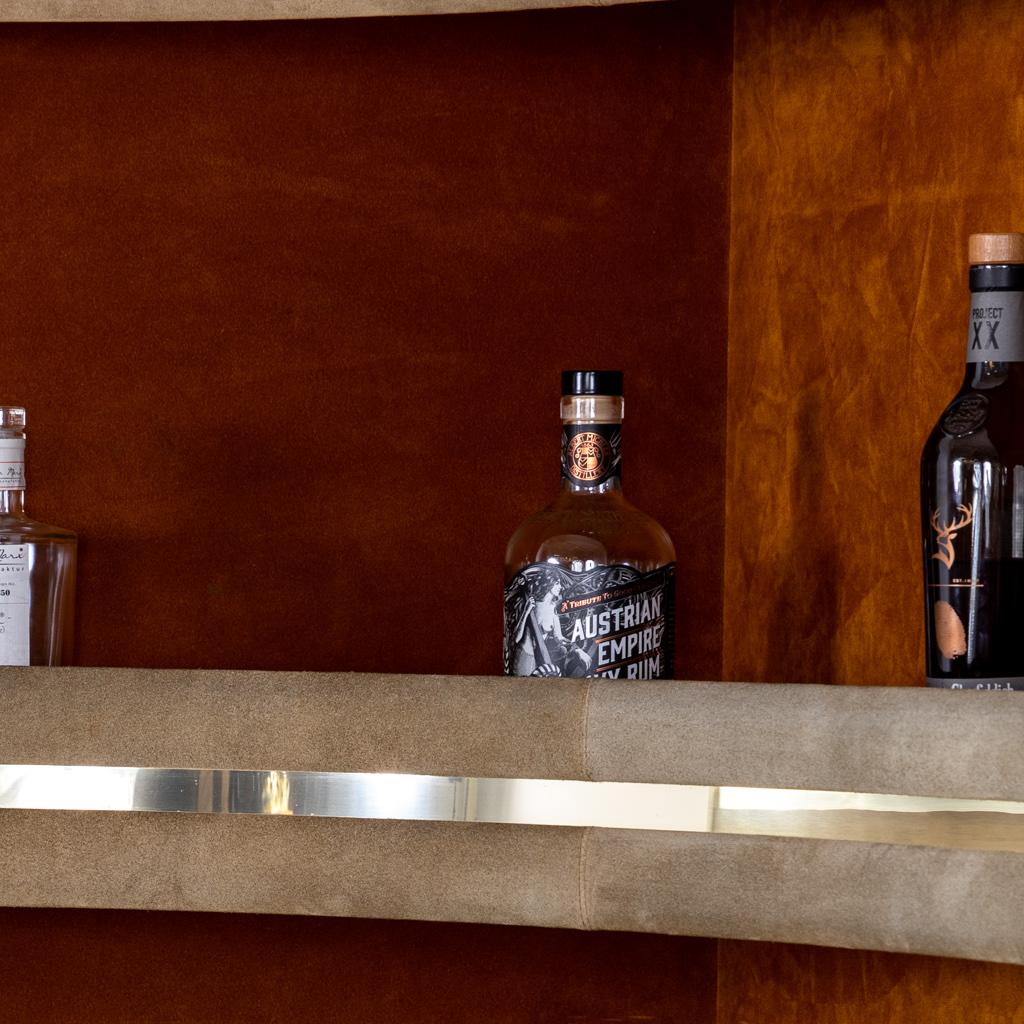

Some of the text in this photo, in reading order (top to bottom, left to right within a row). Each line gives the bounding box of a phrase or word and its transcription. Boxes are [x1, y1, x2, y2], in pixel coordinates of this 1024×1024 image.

[972, 308, 1004, 319] PROJECT
[569, 595, 602, 609] TRIBUTE
[571, 596, 662, 643] AUSTRIAN
[598, 624, 662, 666] EMPIRE
[627, 654, 660, 679] RUM
